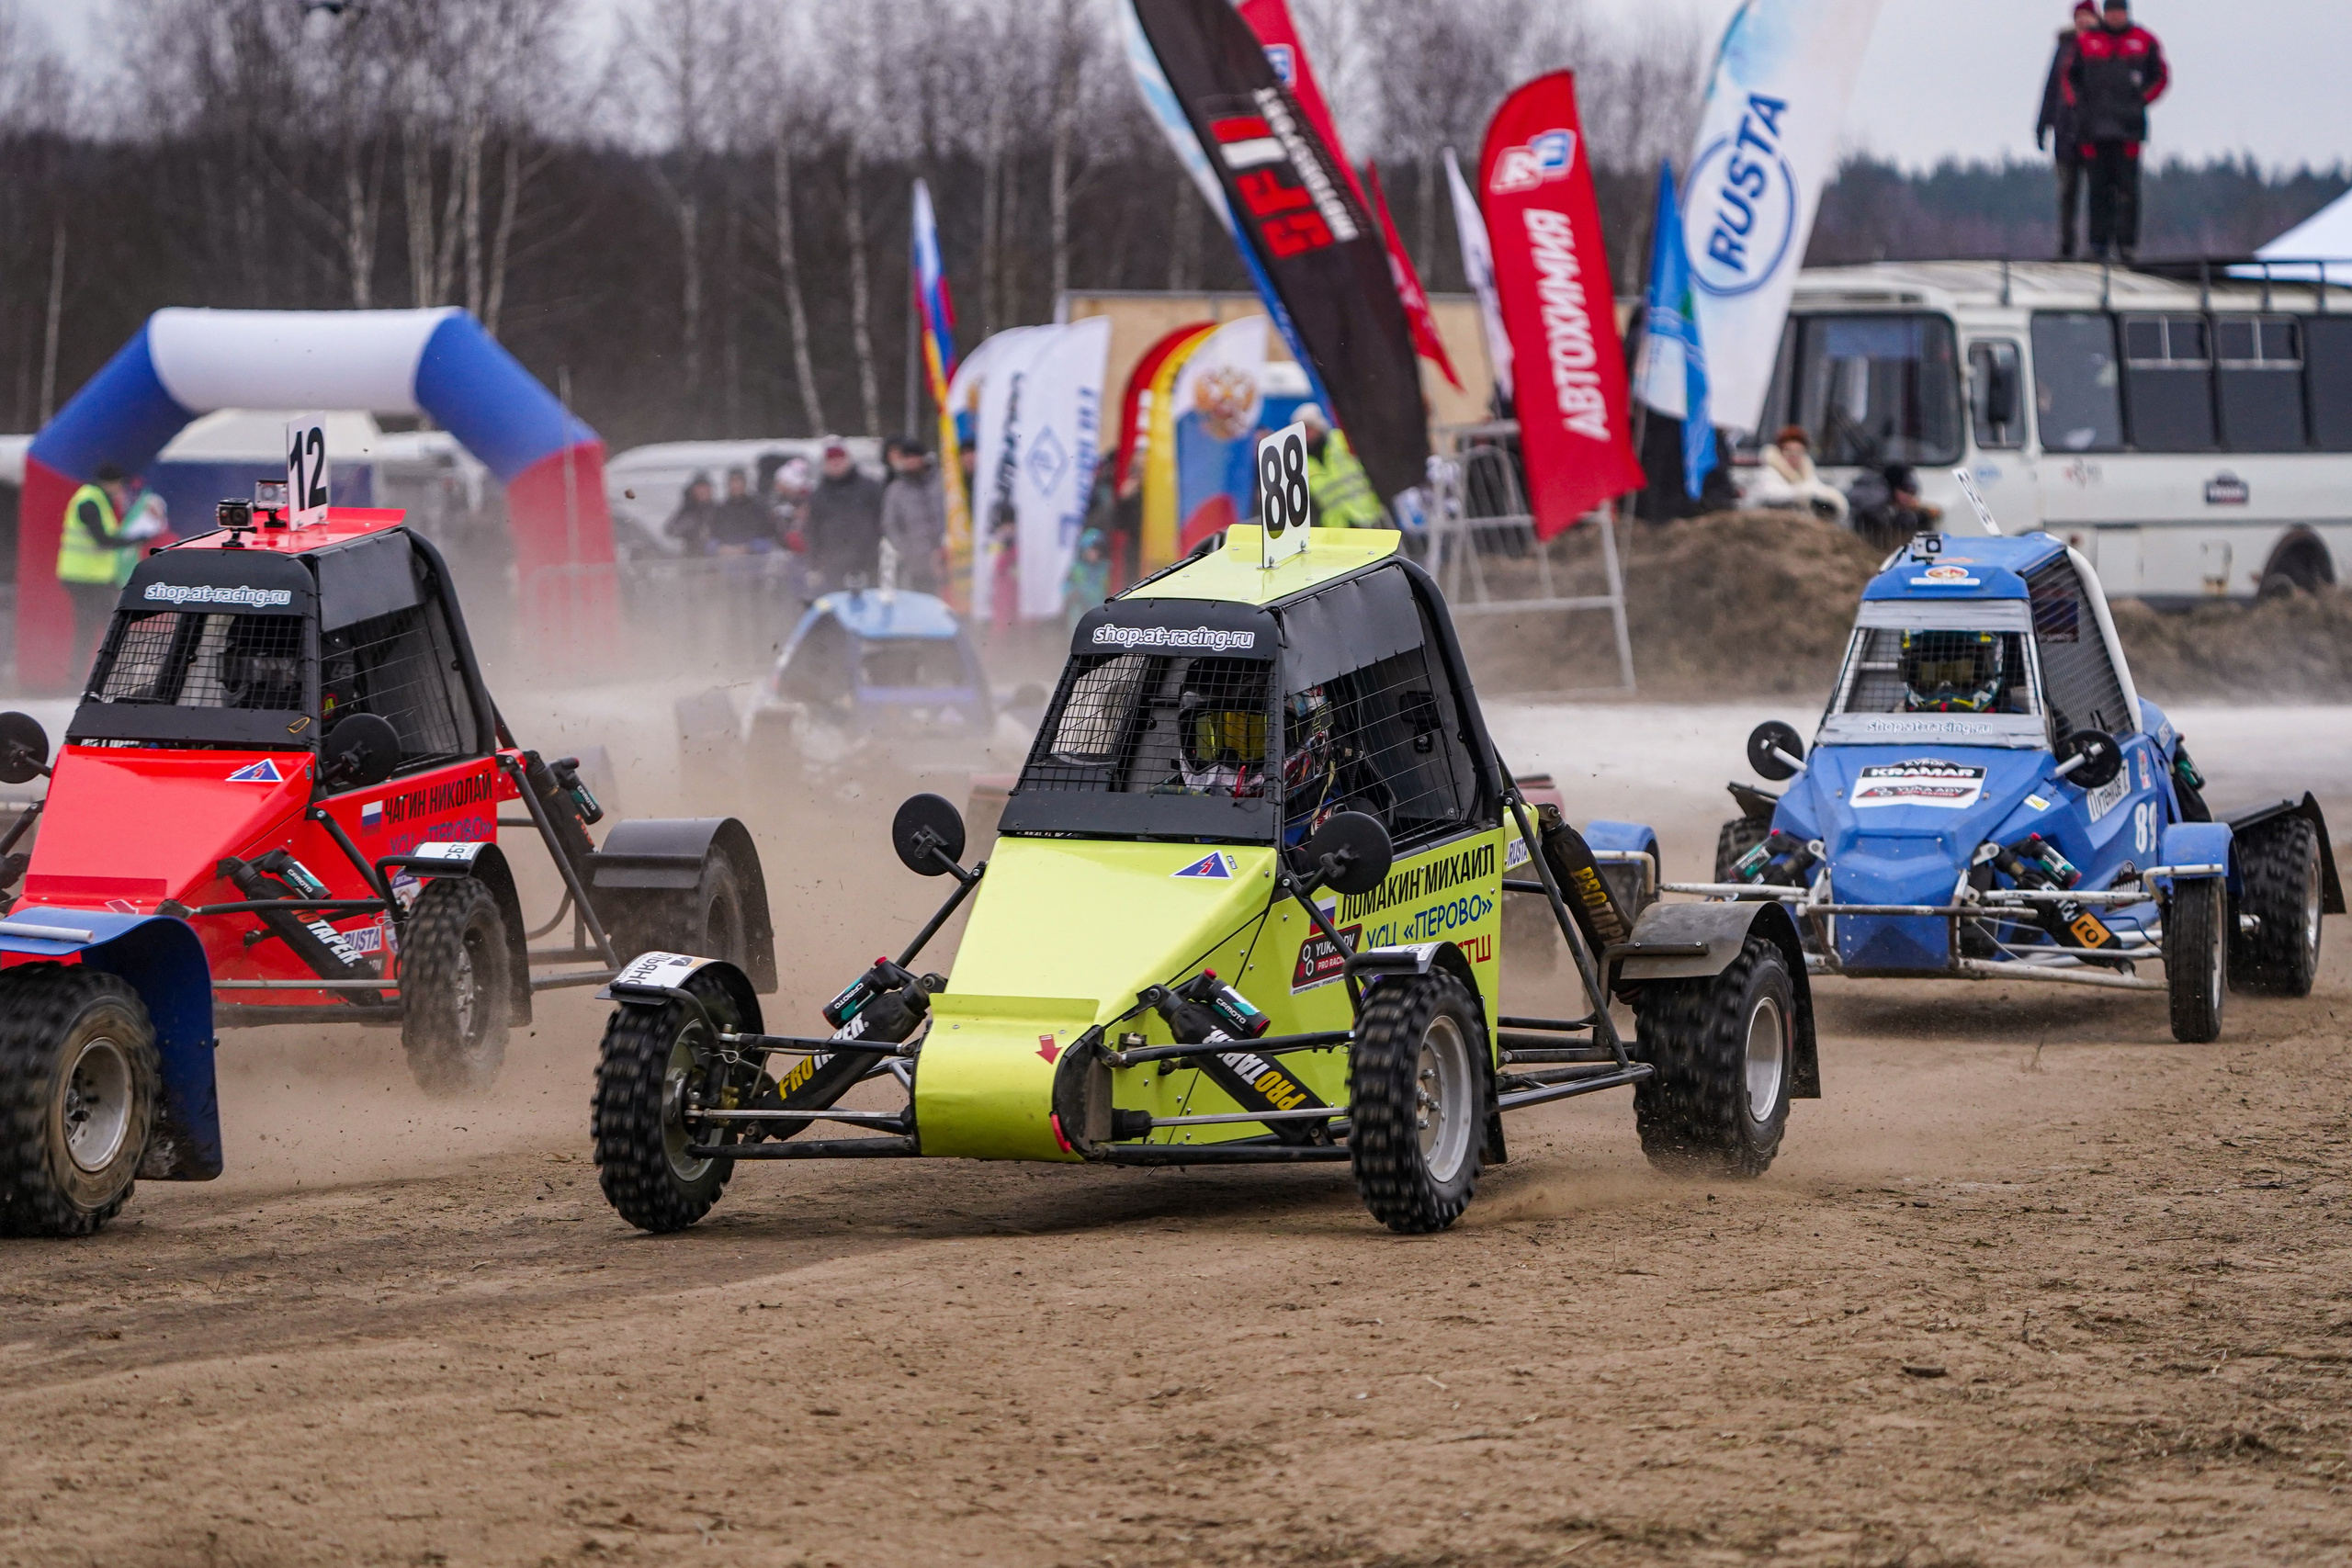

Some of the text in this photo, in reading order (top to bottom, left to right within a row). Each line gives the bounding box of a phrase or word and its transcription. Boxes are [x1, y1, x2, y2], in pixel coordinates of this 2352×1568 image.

[1707, 93, 1789, 273] RUSTA
[1522, 208, 1611, 444] АВТОХИМИЯ
[289, 426, 328, 513] 12
[1261, 434, 1308, 539] 88
[144, 582, 292, 608] shop.at-racing.ru
[1092, 624, 1256, 652] shop.at-racing.ru
[1867, 719, 1994, 734] shop.at-racing.ru
[1871, 766, 1976, 778] KRAMAR
[384, 768, 493, 825] ЧАГИН НИКОЛАЙ
[1508, 838, 1529, 866] RUSTA
[287, 868, 314, 894] CFMOTO
[1340, 843, 1495, 924] ЛОМАКИН МИХАИЛ
[1403, 894, 1494, 942] «ПЕРОВО»
[1317, 957, 1329, 971] PRO
[834, 982, 864, 1010] CFMOTO
[1216, 998, 1247, 1025] CFMOTO
